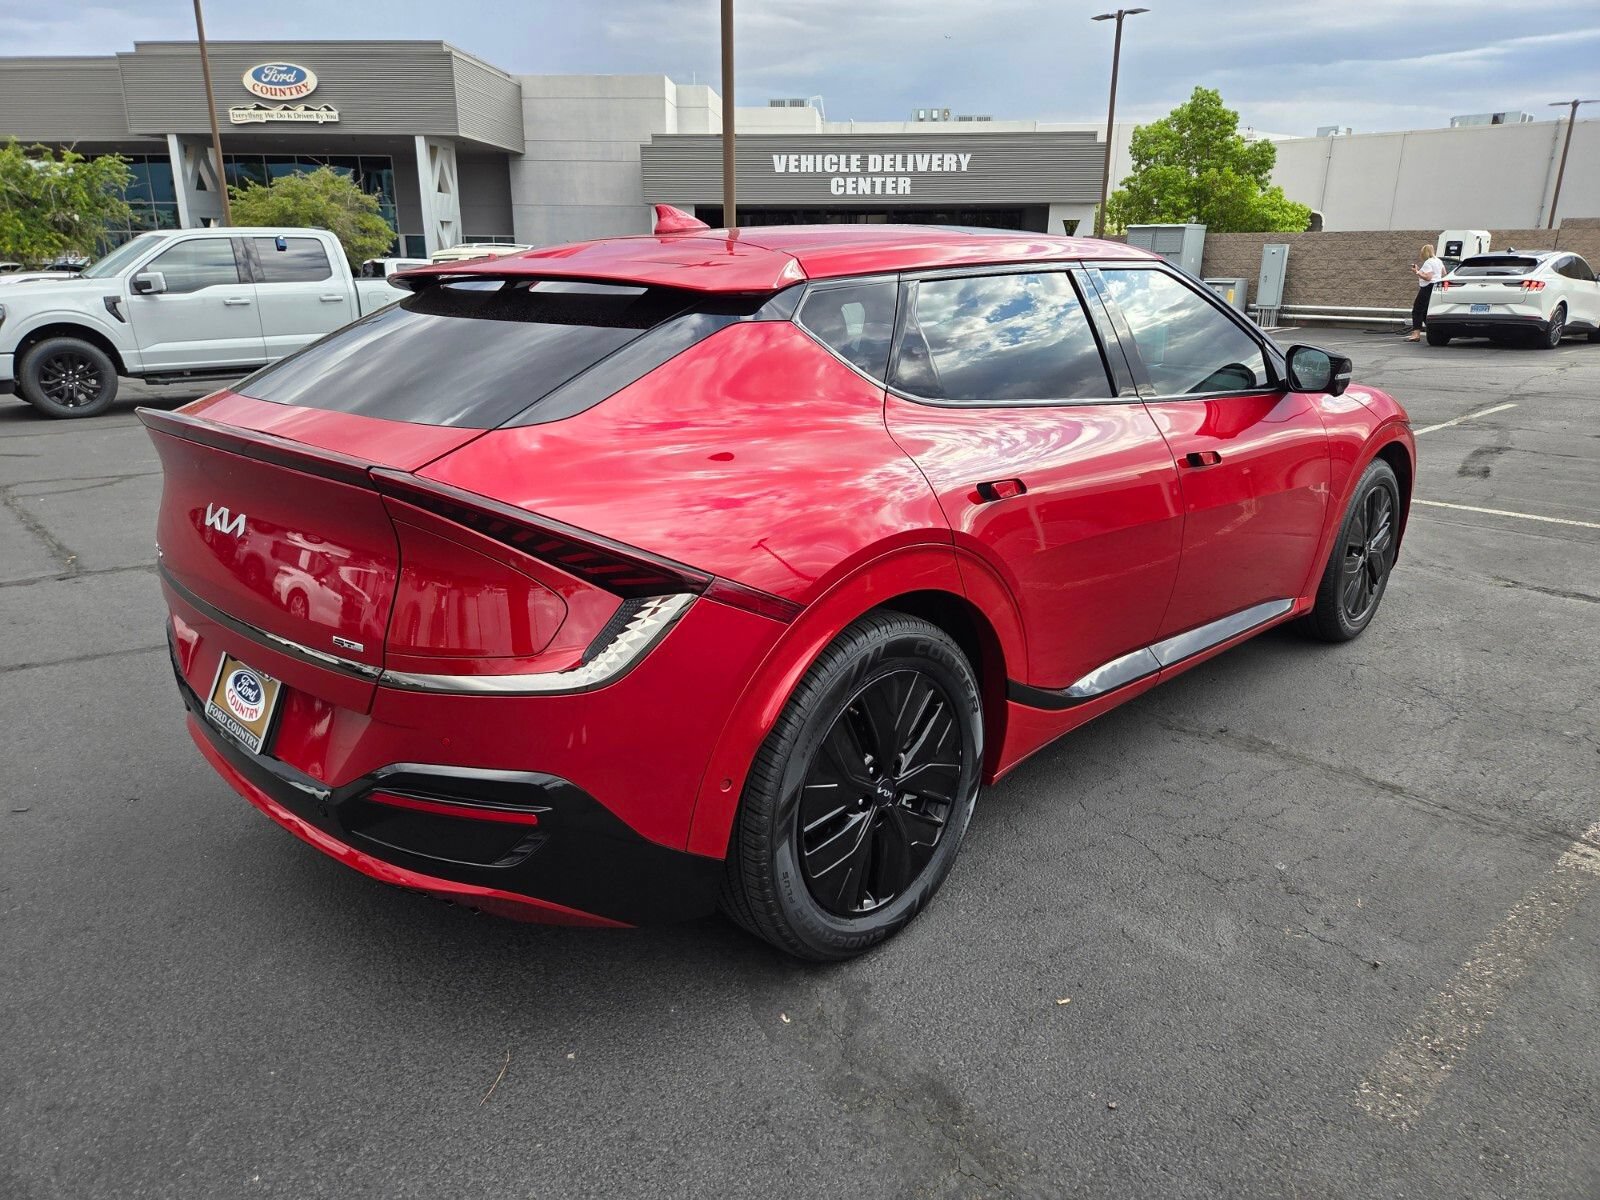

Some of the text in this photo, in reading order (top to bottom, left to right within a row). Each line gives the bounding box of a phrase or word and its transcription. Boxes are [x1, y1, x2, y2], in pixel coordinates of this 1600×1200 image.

[261, 65, 297, 83] Ford
[252, 82, 311, 97] COUNTRY
[232, 111, 263, 121] Everything
[264, 111, 274, 119] We
[325, 112, 337, 120] You
[772, 153, 972, 173] VEHICLE DELIVERY
[830, 177, 912, 195] CENTER
[204, 502, 247, 538] KIA
[236, 674, 259, 702] Ford
[227, 688, 260, 720] COUNTRY
[209, 704, 260, 750] FORD COUNTRY
